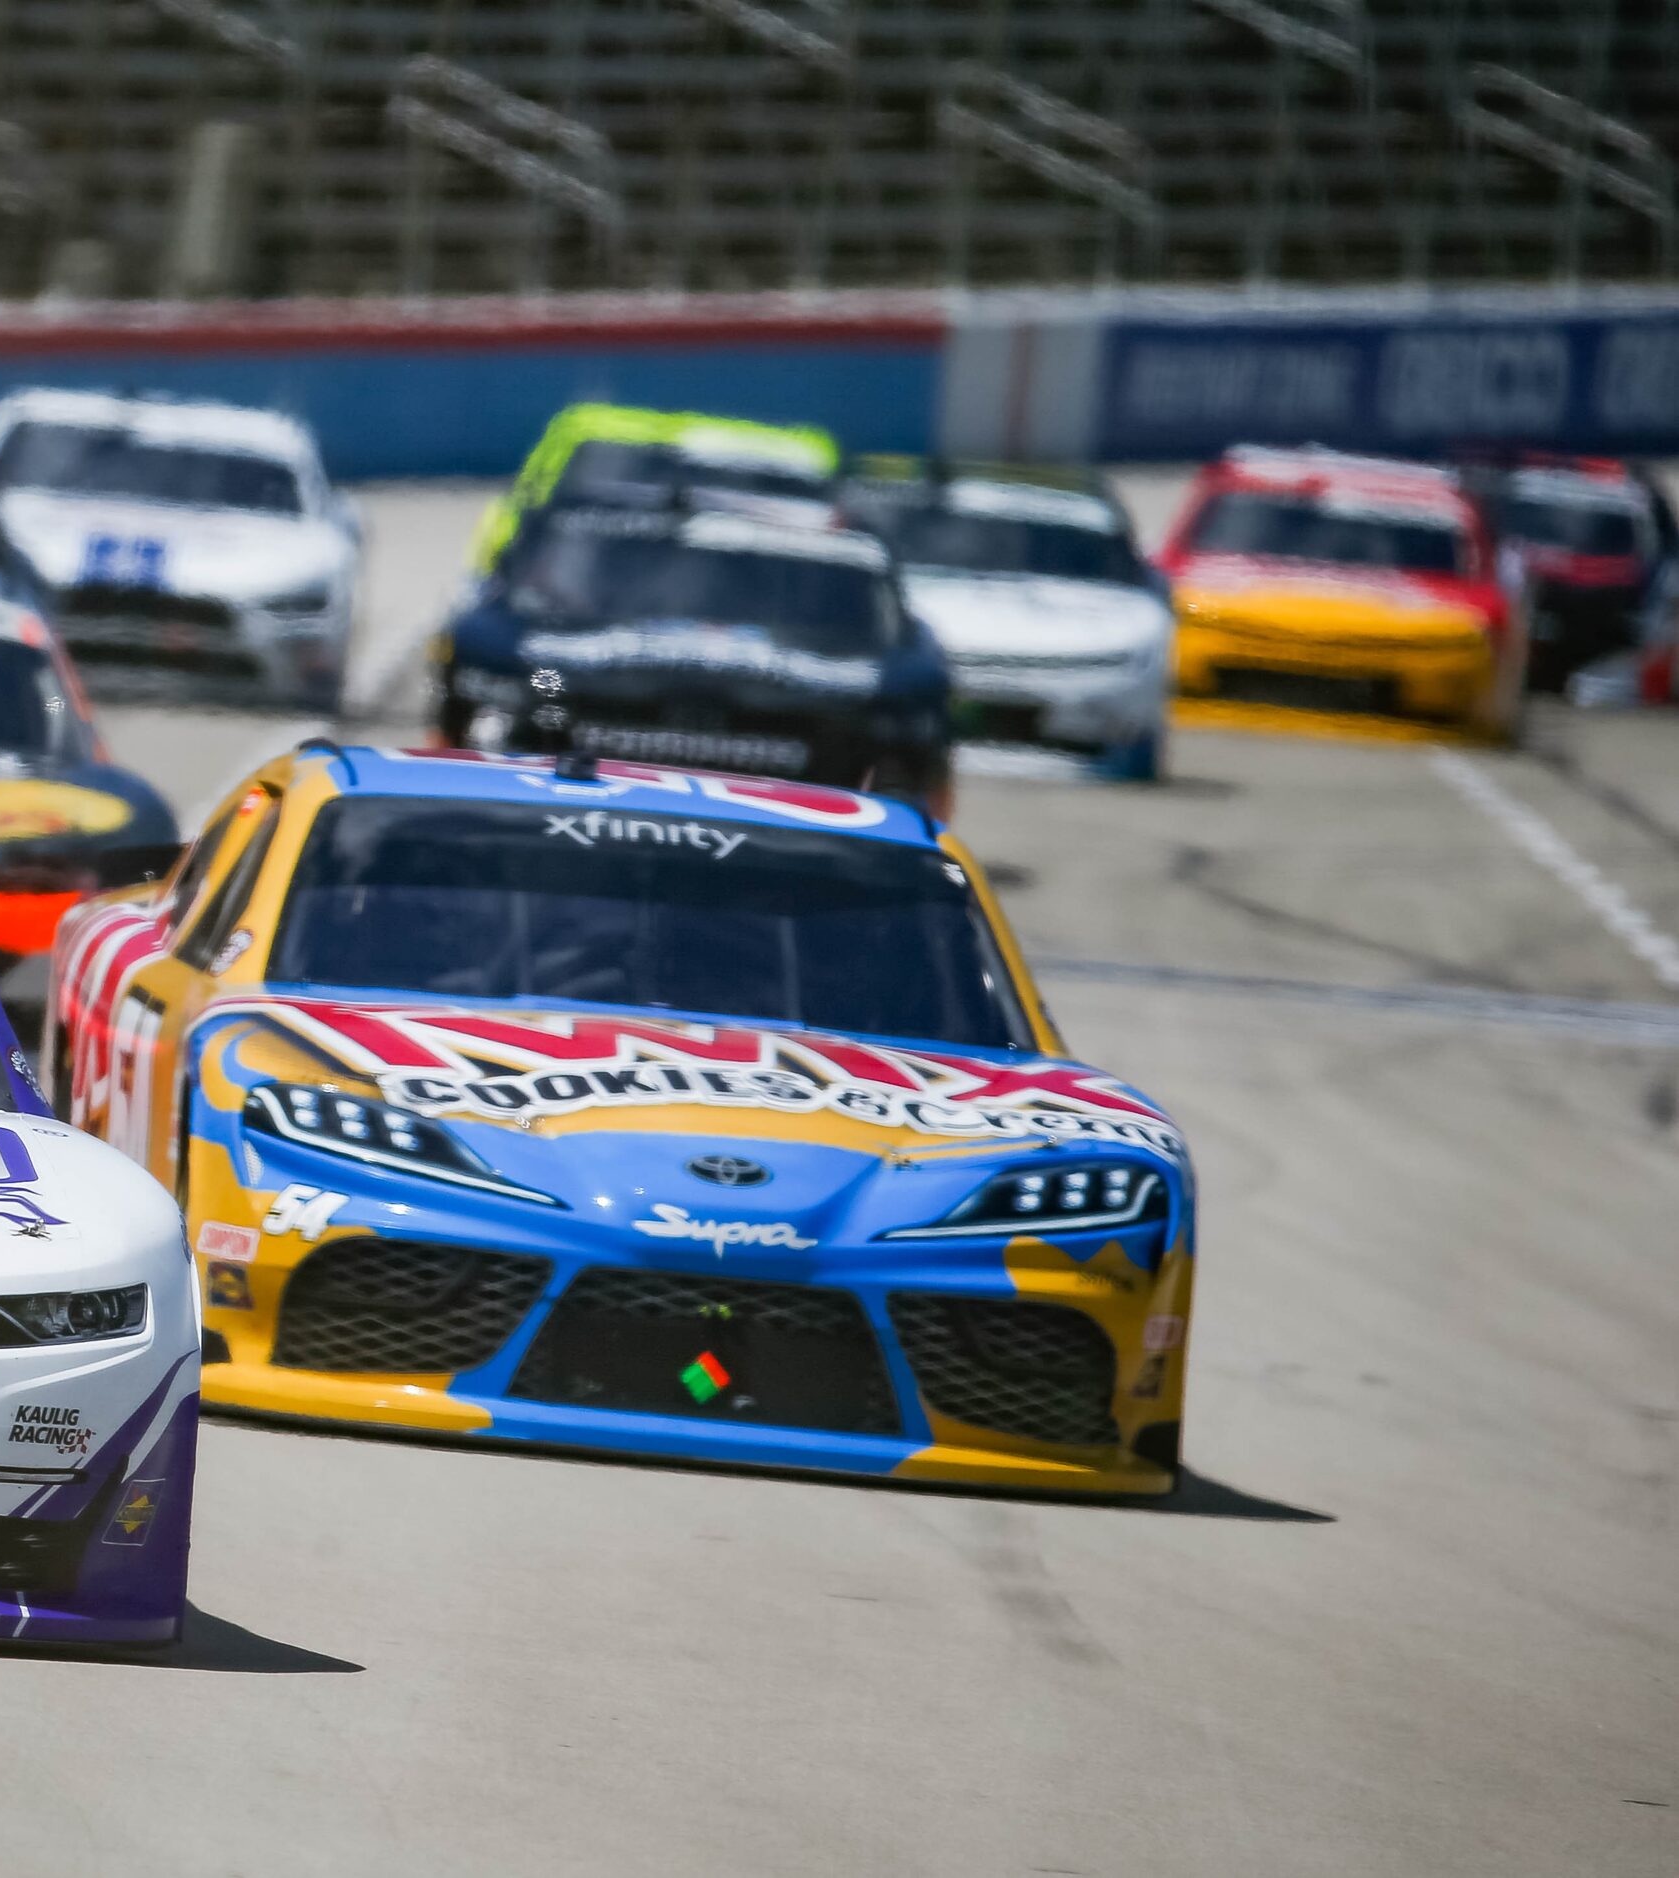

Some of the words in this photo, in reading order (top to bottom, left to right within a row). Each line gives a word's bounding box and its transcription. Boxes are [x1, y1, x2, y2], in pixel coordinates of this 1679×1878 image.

[544, 810, 749, 860] xfinity
[202, 996, 1182, 1124] TWIX
[392, 1064, 819, 1114] COOKIES
[261, 1182, 350, 1241] 54
[633, 1203, 813, 1259] Supra
[8, 1425, 79, 1446] RACING
[15, 1405, 80, 1426] KAULIG
